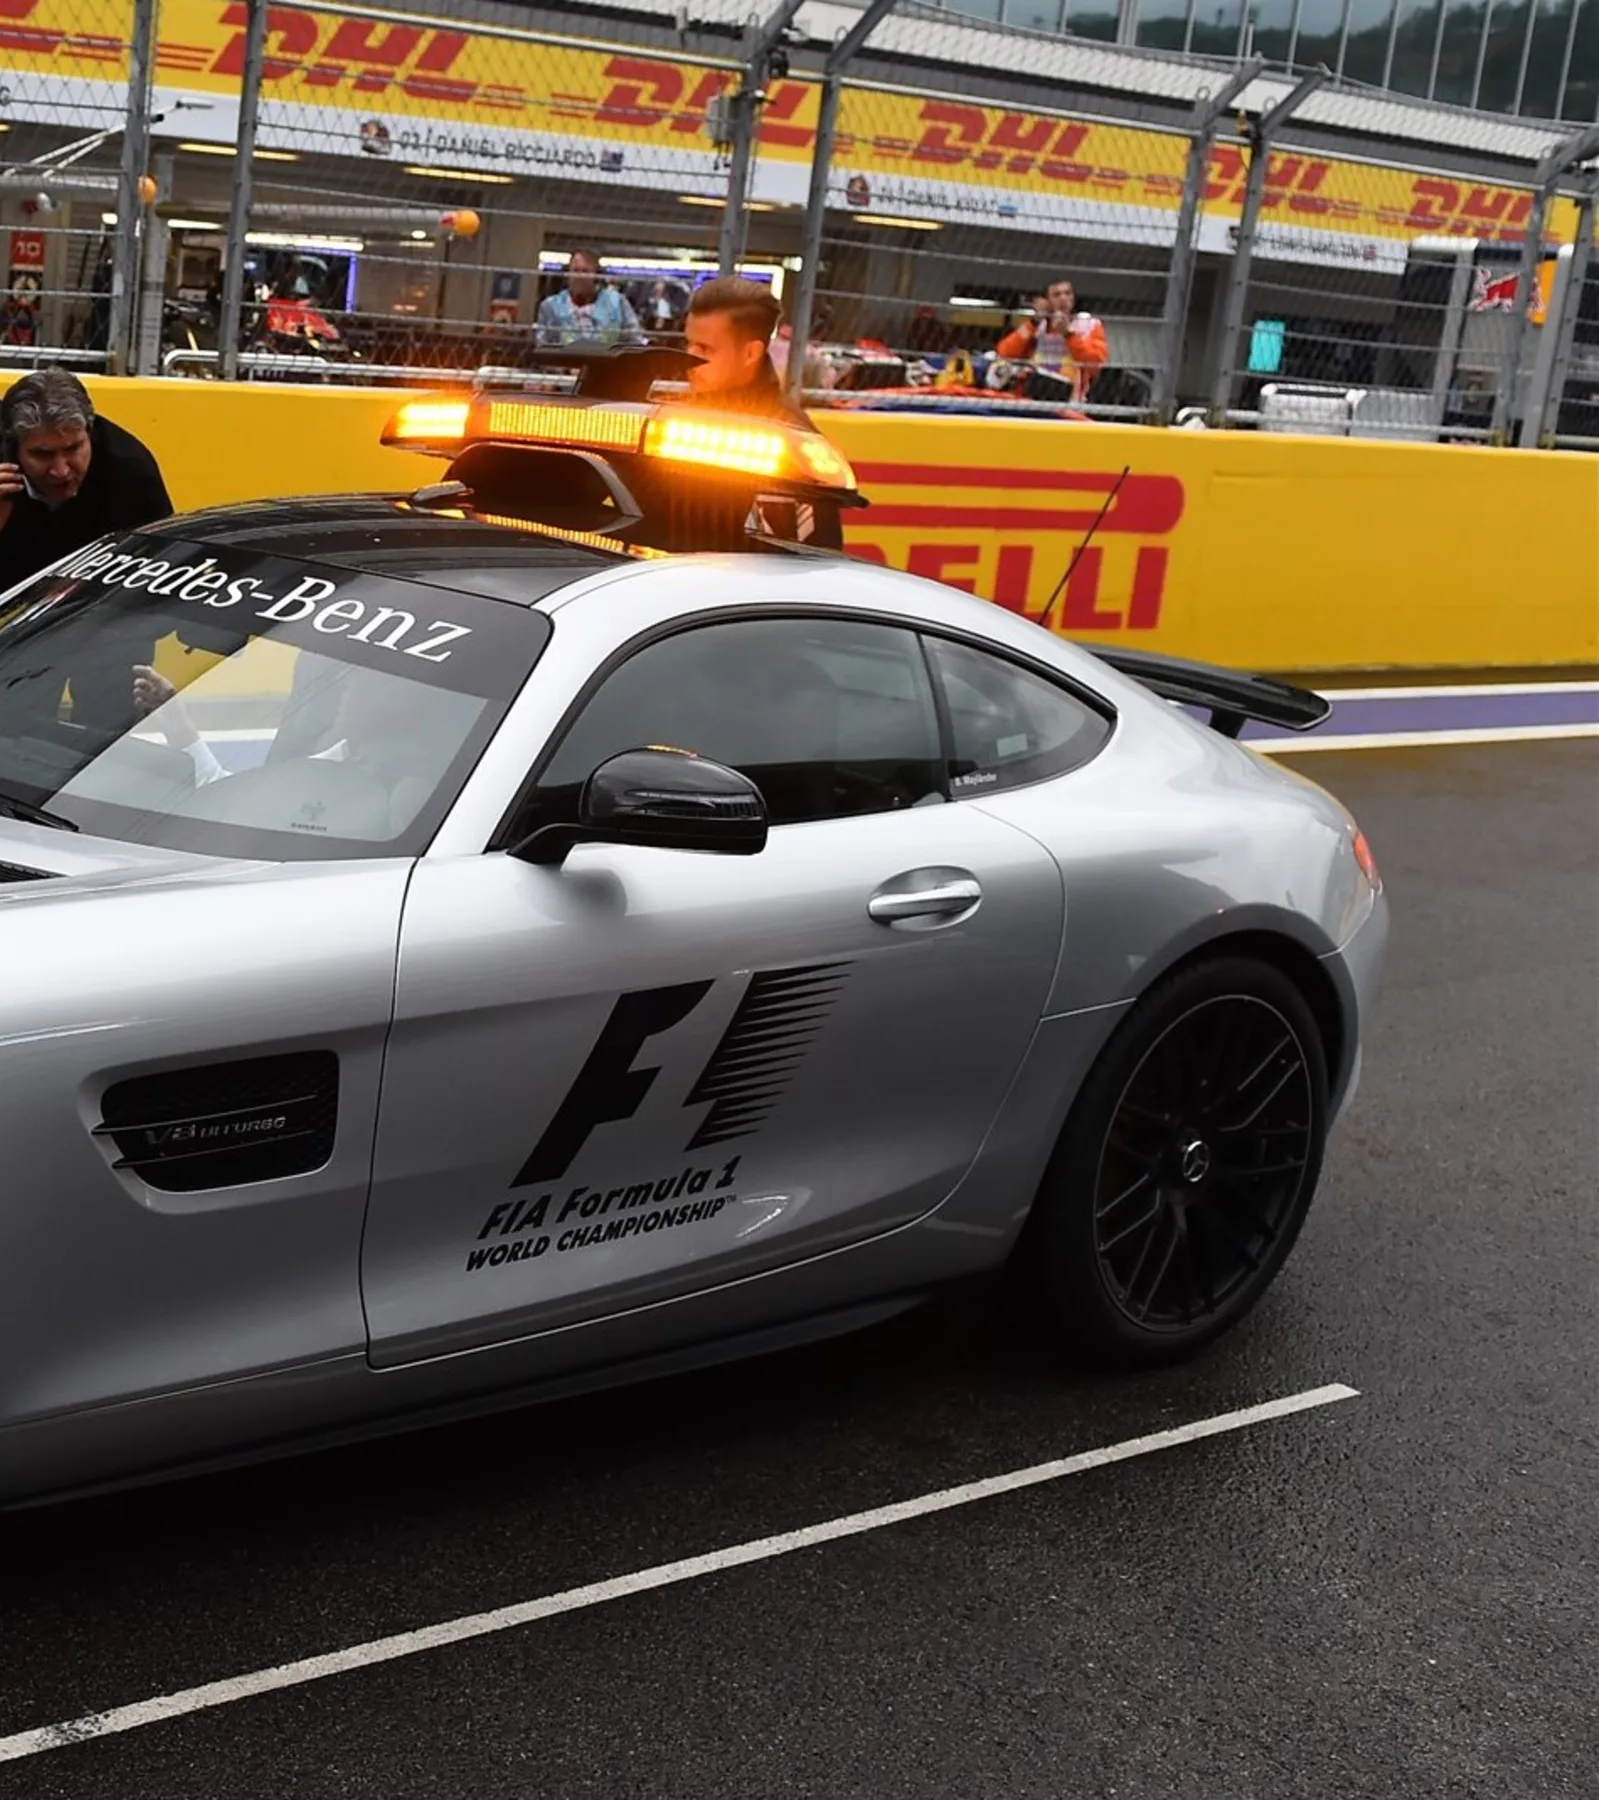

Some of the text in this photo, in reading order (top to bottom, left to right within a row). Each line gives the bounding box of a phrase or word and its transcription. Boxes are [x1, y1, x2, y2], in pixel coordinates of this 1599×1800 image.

[209, 4, 479, 103] DHL
[912, 100, 1093, 182] DHL
[1404, 179, 1536, 242] DHL
[50, 540, 473, 664] Mercedes-Benz
[477, 1154, 742, 1240] FIA Formula 1
[465, 1235, 551, 1272] WORLD
